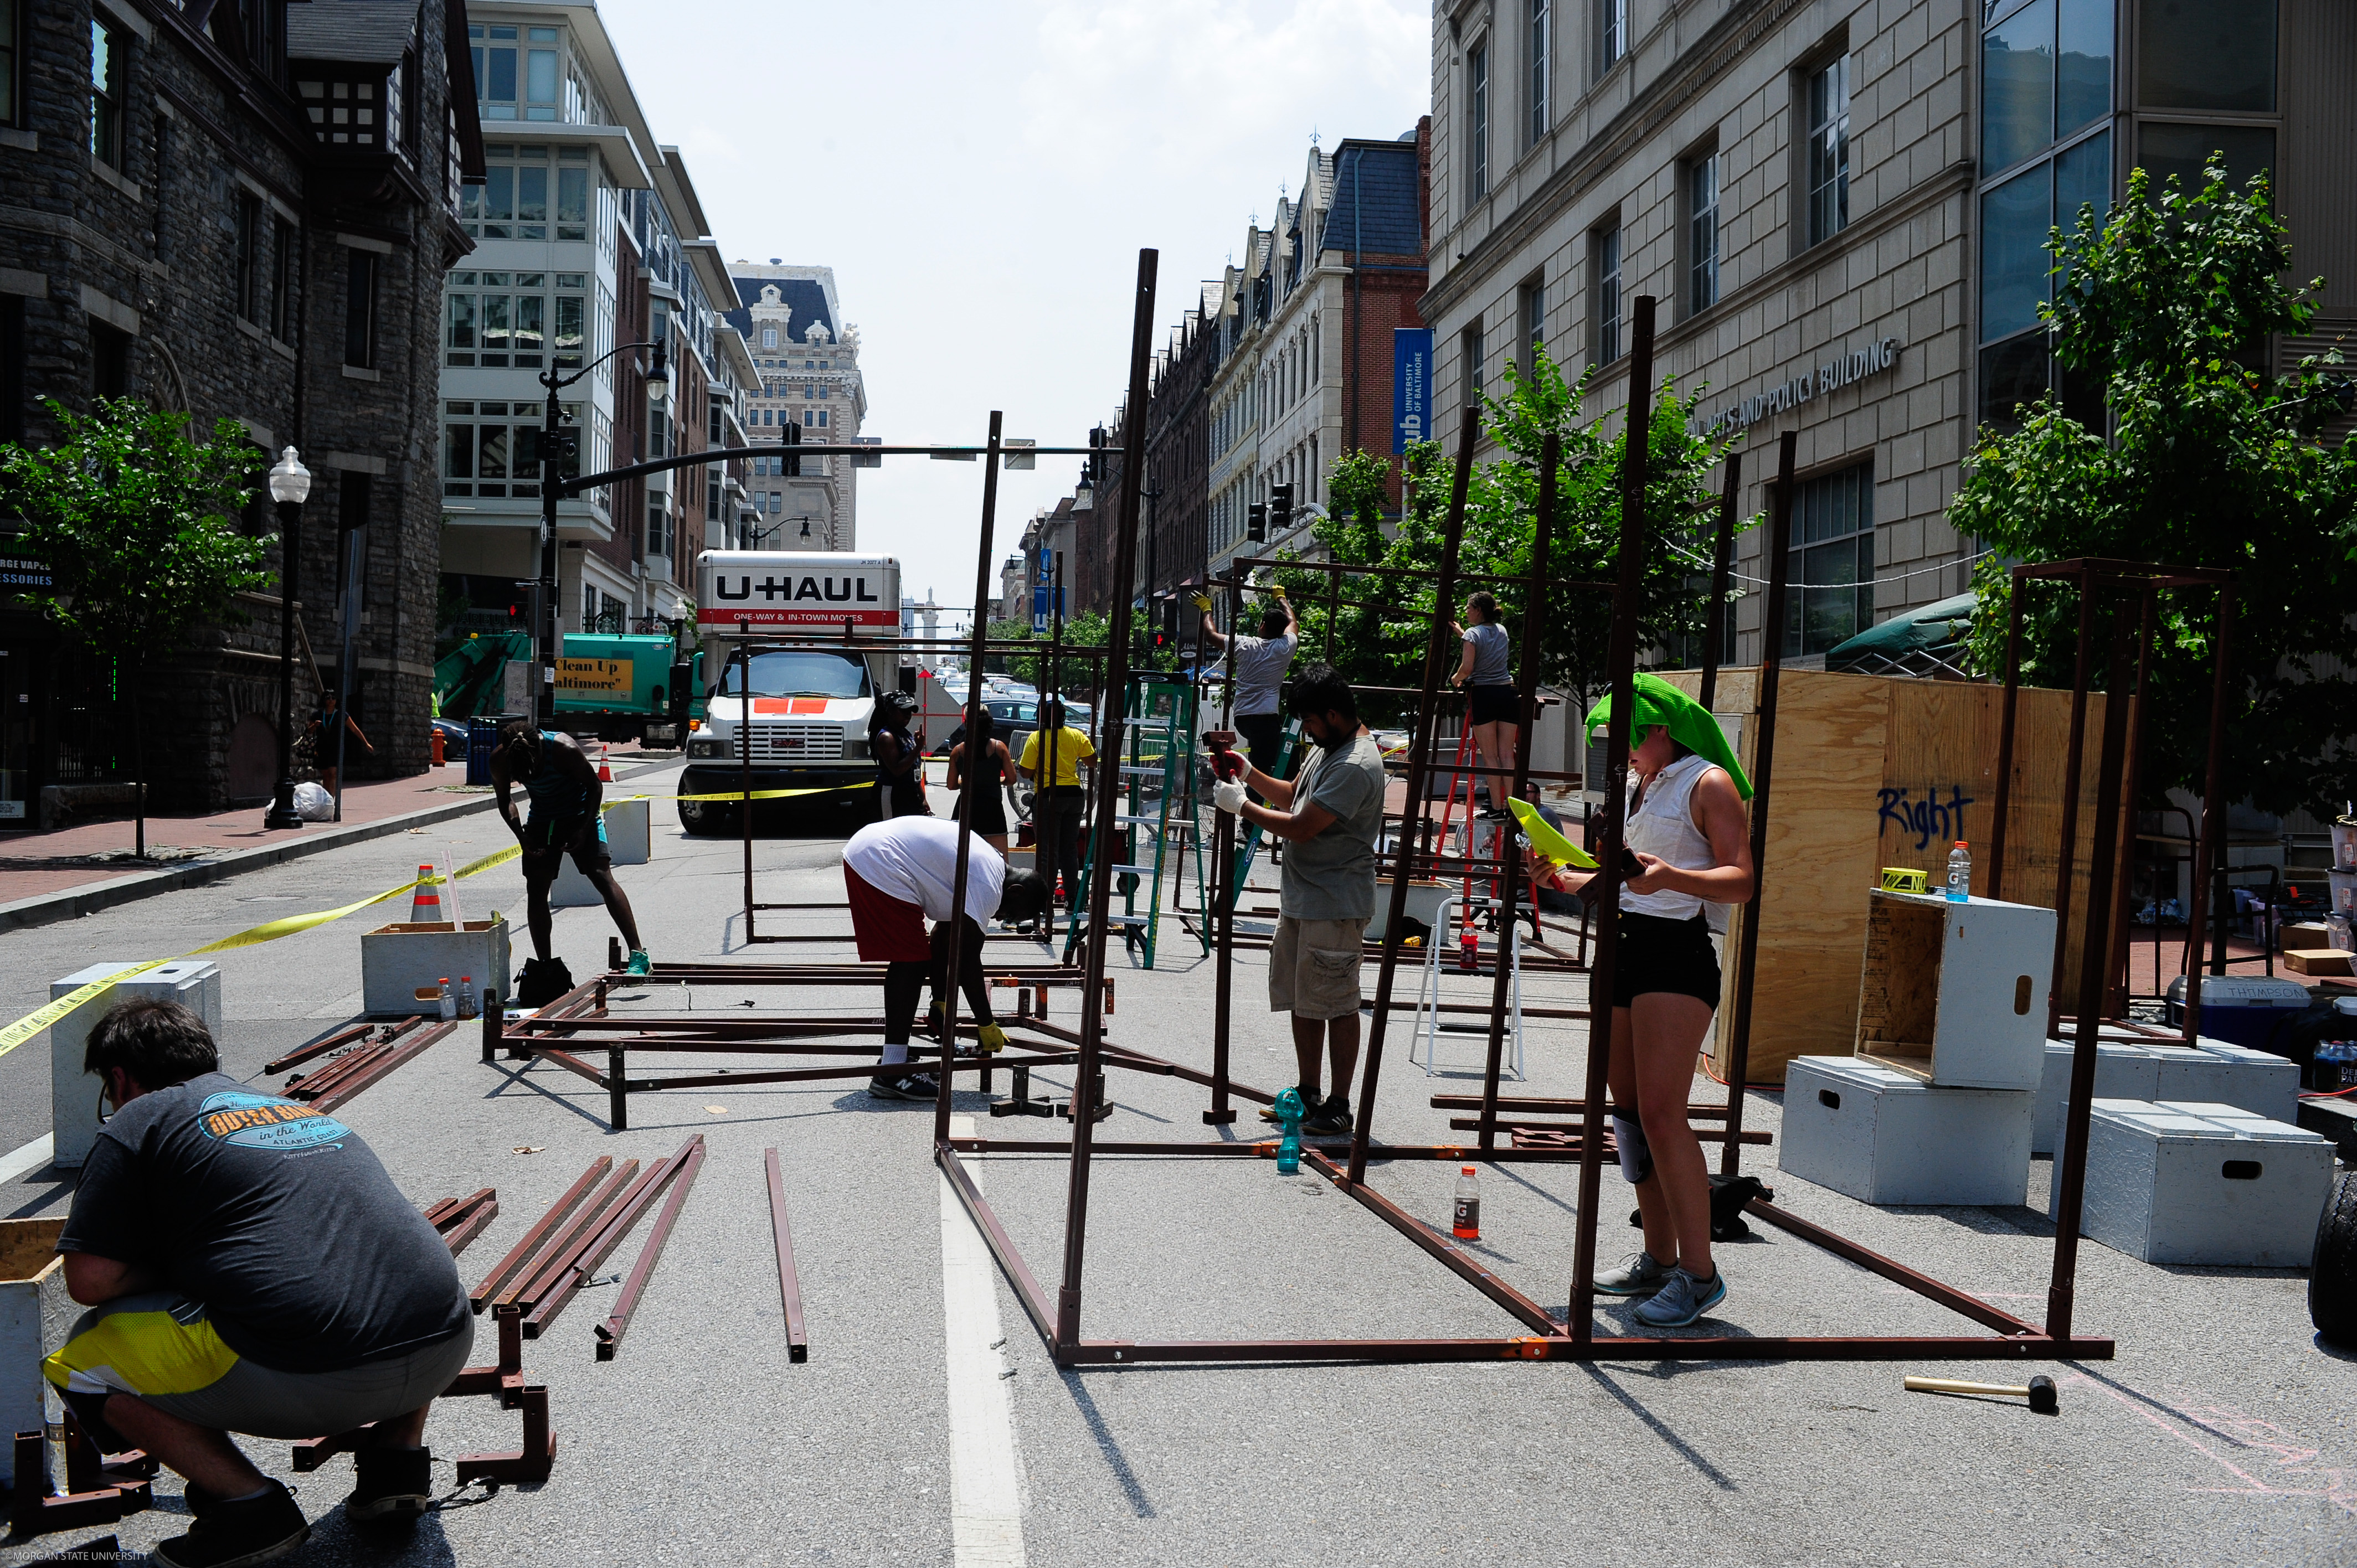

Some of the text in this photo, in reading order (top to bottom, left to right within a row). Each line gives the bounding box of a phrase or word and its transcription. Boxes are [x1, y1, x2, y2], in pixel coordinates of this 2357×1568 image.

[1405, 363, 1413, 411] UNIVERSITY
[1414, 352, 1422, 412] OF BALTIMORE
[1738, 395, 1763, 429] AND
[1768, 371, 1814, 416] POLICY
[1820, 337, 1896, 394] BUILDING
[554, 659, 617, 675] Clean Up
[555, 677, 620, 689] altimore"
[772, 739, 804, 747] GMC
[1877, 785, 1975, 850] Right
[1948, 872, 1959, 885] G
[2228, 988, 2304, 998] THOMPSON
[208, 1105, 327, 1137] OUTER BAN
[259, 1118, 333, 1140] in the World
[273, 1129, 338, 1145] ATLANTIC COAST
[1457, 1204, 1467, 1217] G
